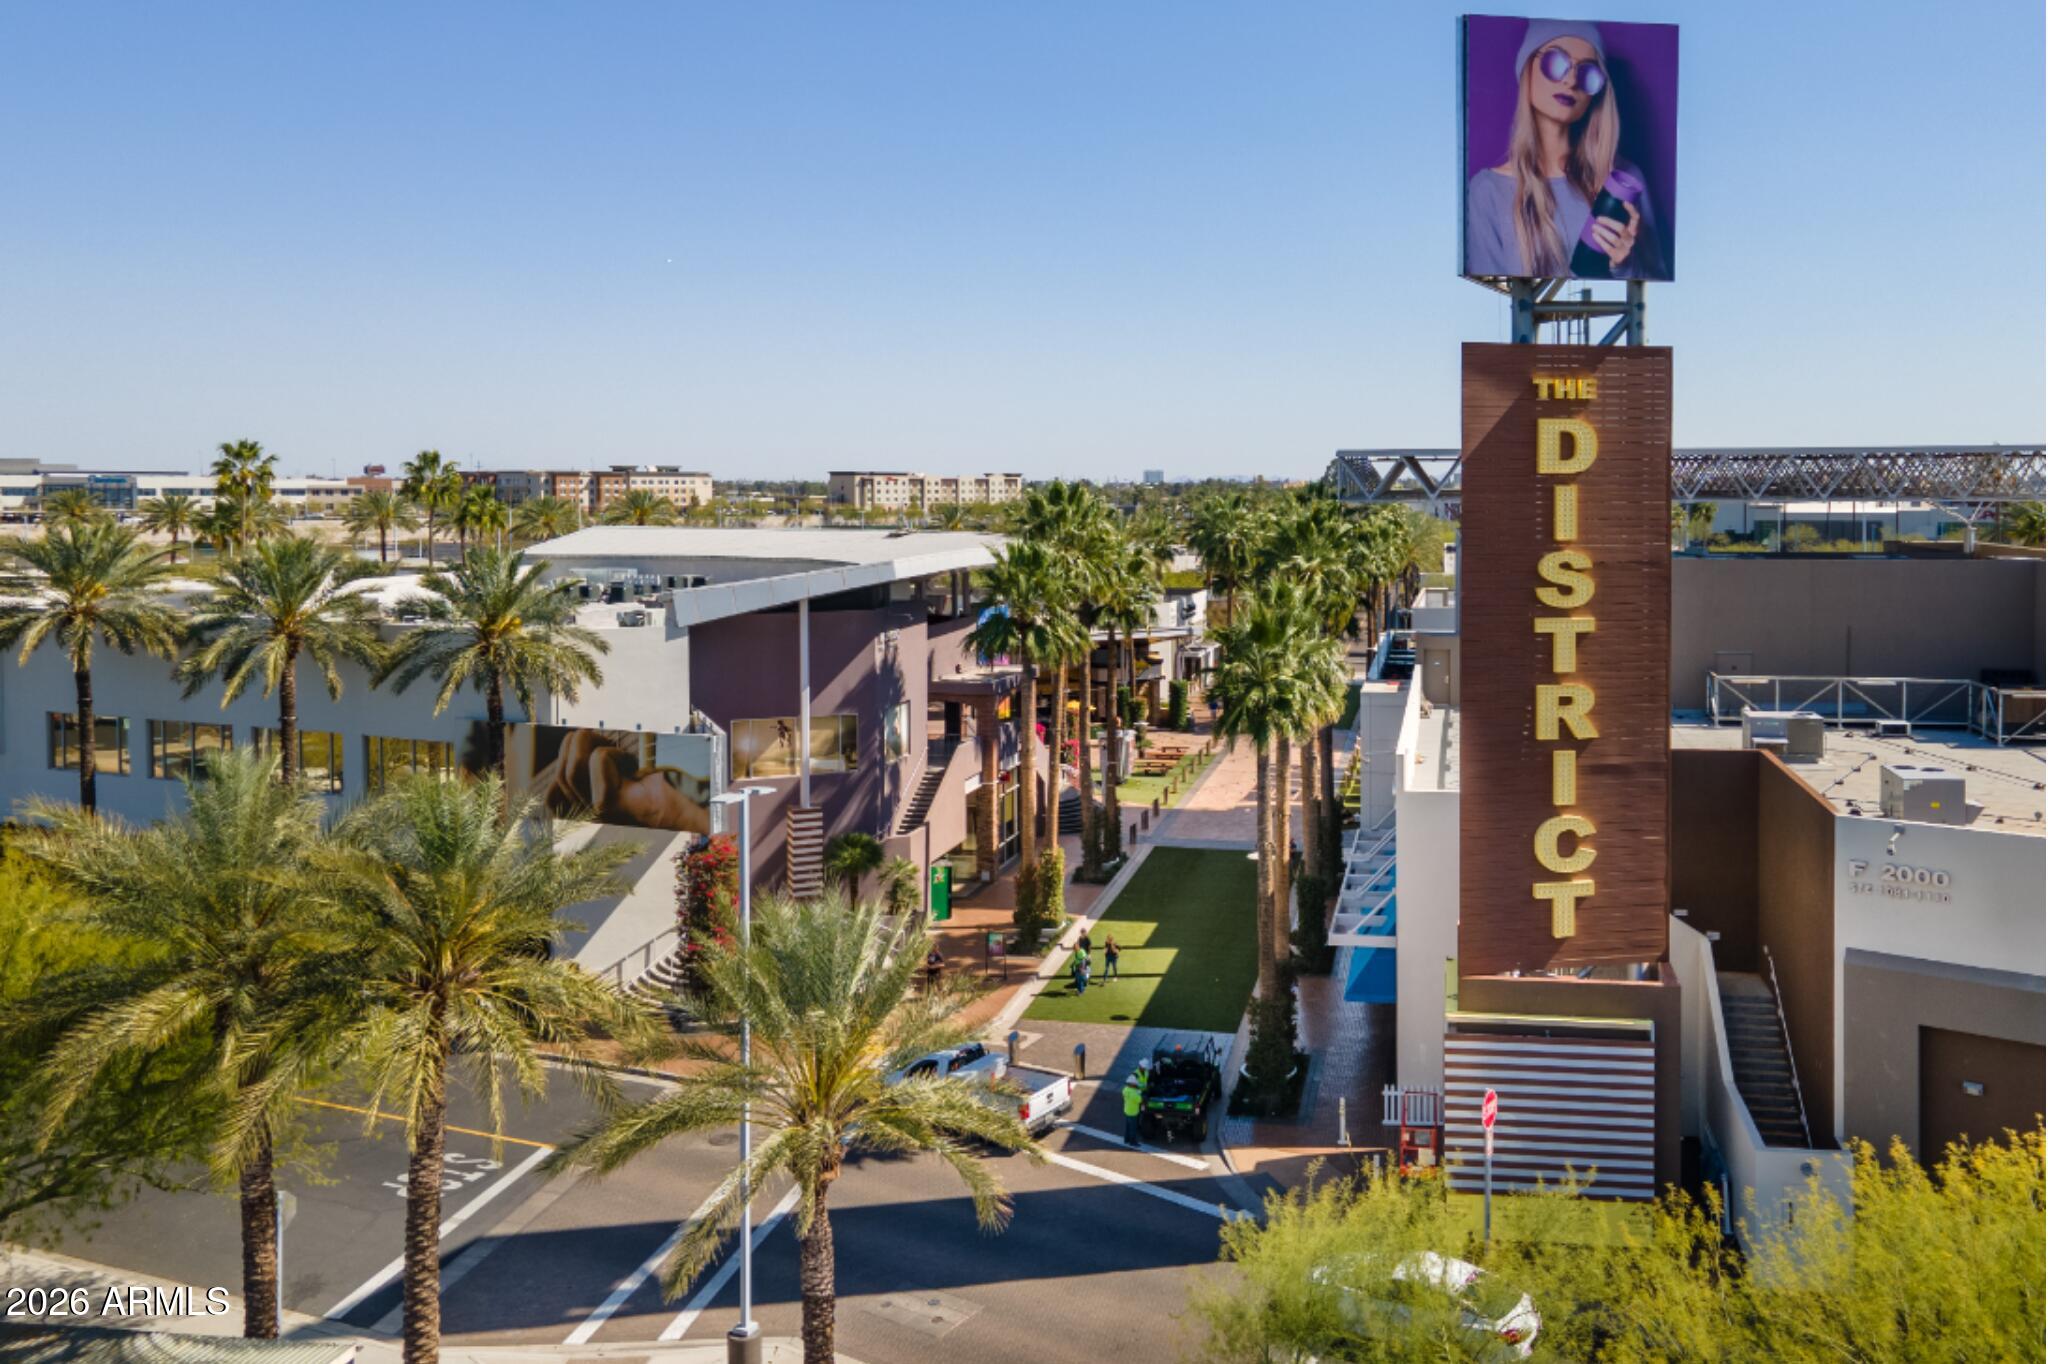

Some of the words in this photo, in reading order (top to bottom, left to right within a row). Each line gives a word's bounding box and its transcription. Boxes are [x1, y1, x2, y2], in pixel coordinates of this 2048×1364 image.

[1532, 376, 1598, 400] THE
[1532, 417, 1599, 939] DISTRICT
[1848, 859, 1868, 878] F
[1880, 862, 1951, 887] 2000
